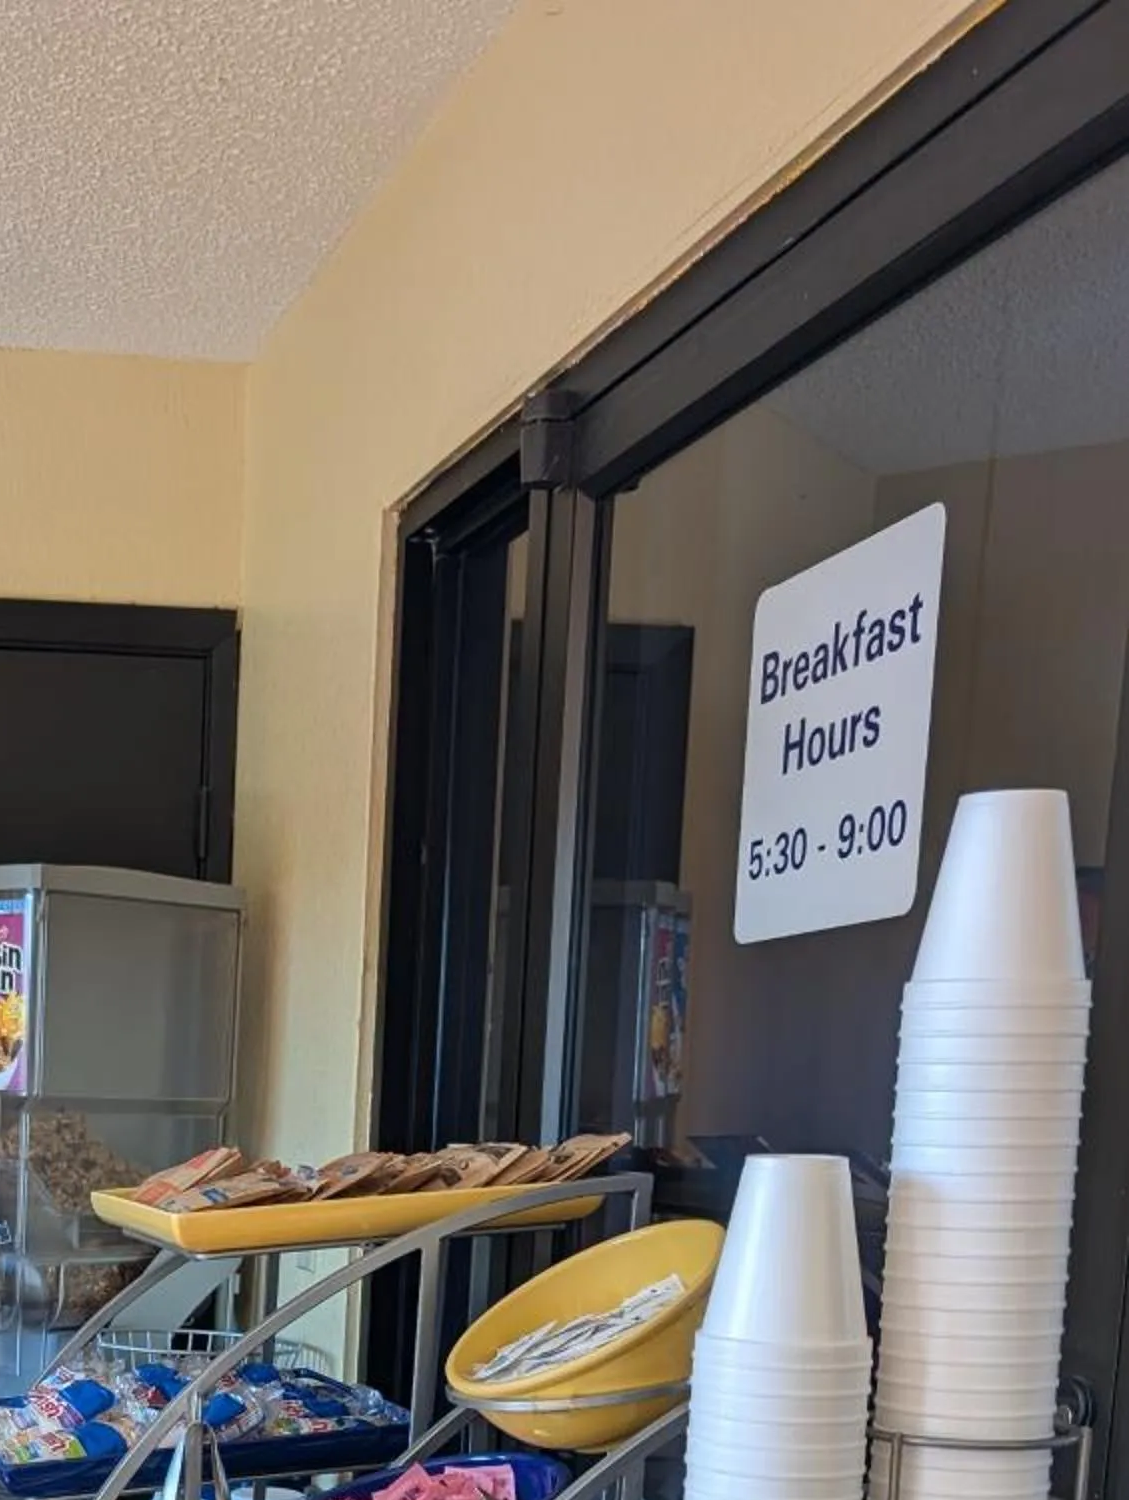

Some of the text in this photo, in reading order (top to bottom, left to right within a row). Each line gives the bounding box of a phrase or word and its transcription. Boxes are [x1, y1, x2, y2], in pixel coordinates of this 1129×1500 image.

[760, 593, 924, 705] Breakfast
[782, 705, 881, 775] Hours
[748, 827, 808, 881] 5:30
[838, 800, 907, 859] 9:00
